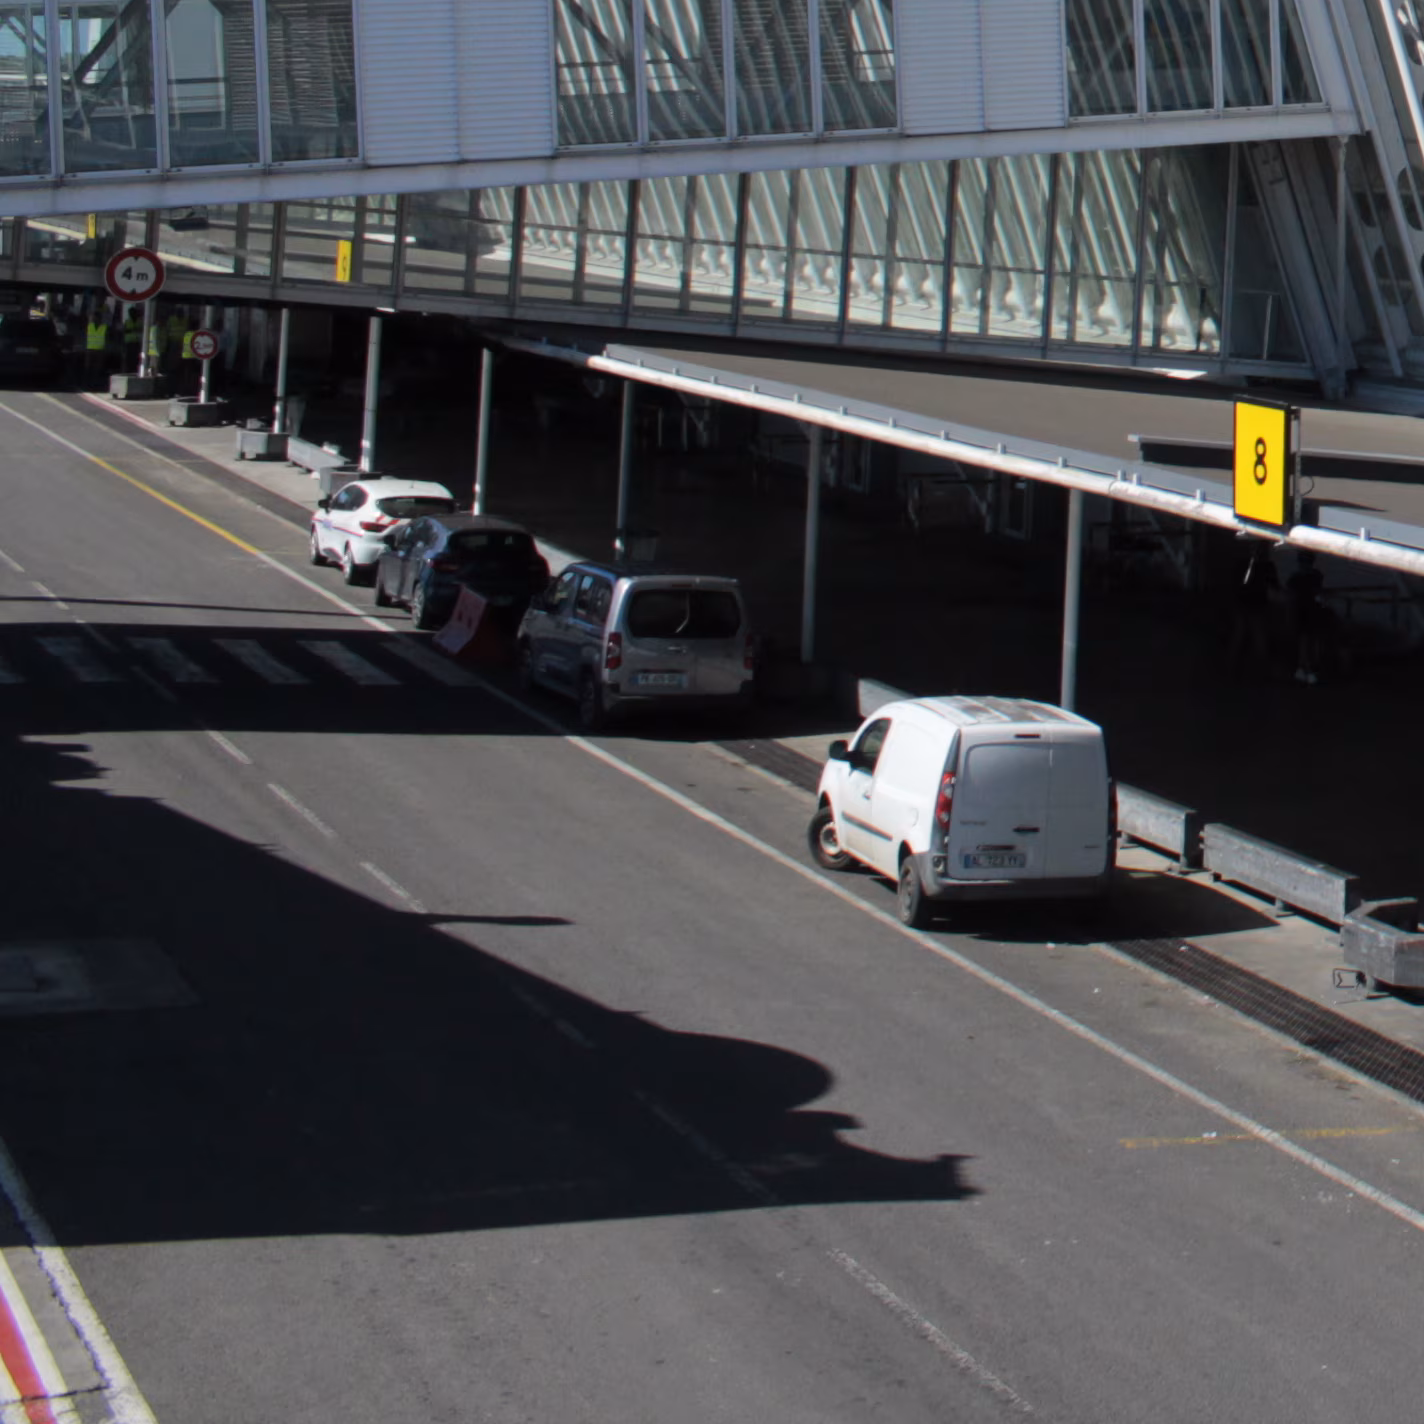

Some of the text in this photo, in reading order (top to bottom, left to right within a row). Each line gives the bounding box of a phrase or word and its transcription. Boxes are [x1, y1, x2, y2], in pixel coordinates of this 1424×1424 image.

[122, 266, 149, 282] 4 m
[1254, 437, 1267, 486] 8
